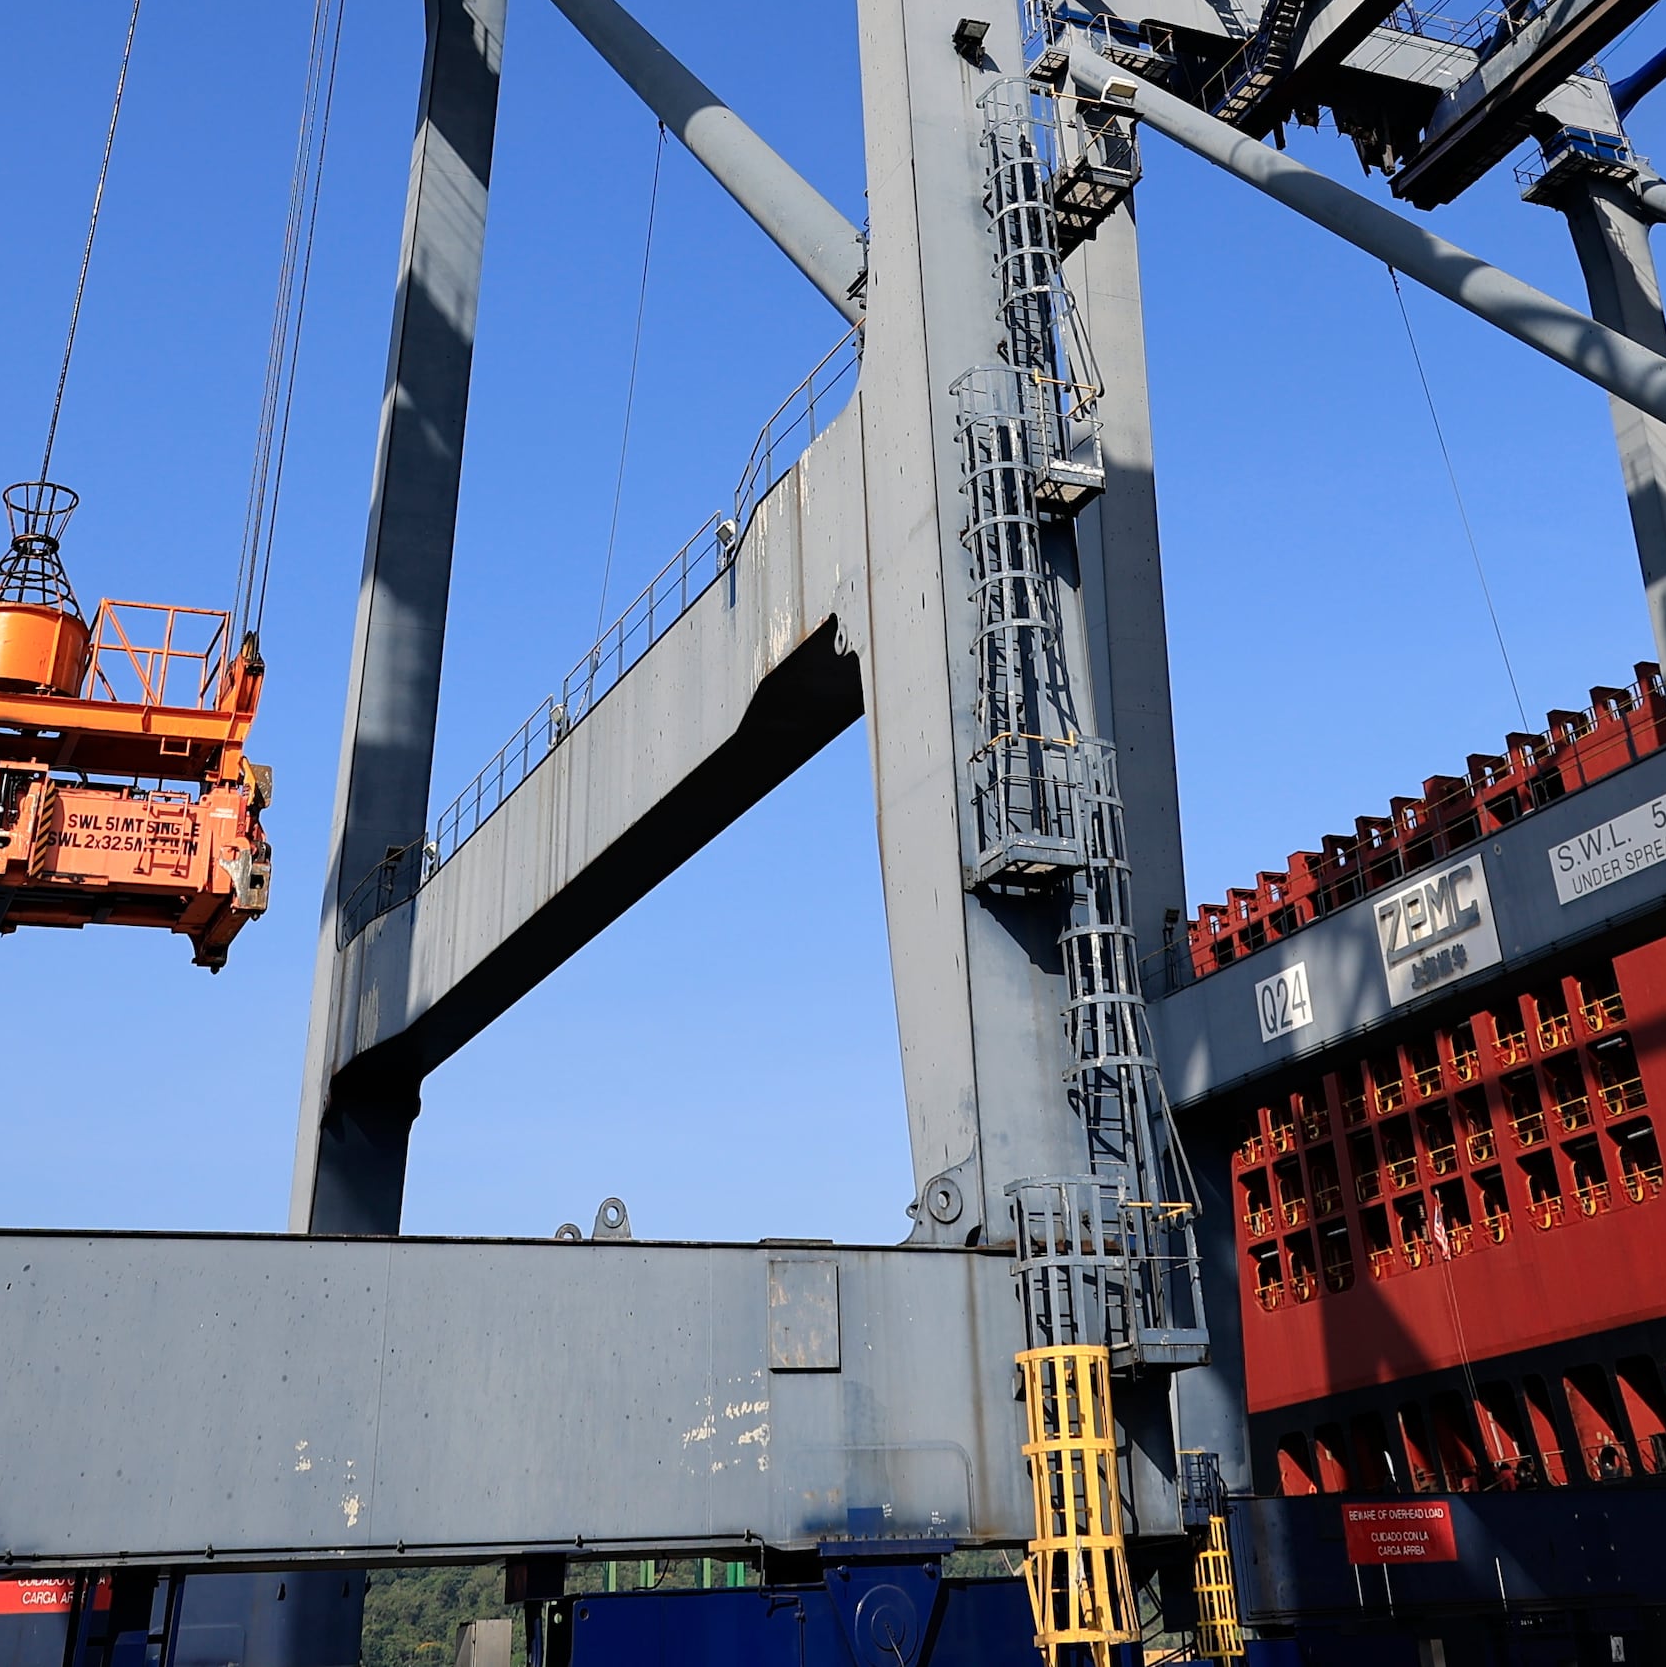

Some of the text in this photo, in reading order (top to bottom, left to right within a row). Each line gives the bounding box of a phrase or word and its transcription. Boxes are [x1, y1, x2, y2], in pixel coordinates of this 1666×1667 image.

[67, 813, 102, 831] SWL
[146, 820, 201, 837] SINGLE
[46, 831, 83, 848] SWL
[1556, 823, 1633, 873] S.W.L.
[1572, 859, 1623, 894] UNDER
[1378, 864, 1482, 968] ZPMC
[1261, 969, 1307, 1035] Q24
[1349, 1508, 1444, 1522] BEWARE OF OVERHEAD LOAD
[1371, 1531, 1429, 1542] CUIDADO CON LA
[1378, 1545, 1426, 1556] CARGA ARRIBA
[22, 1591, 57, 1605] CARGA
